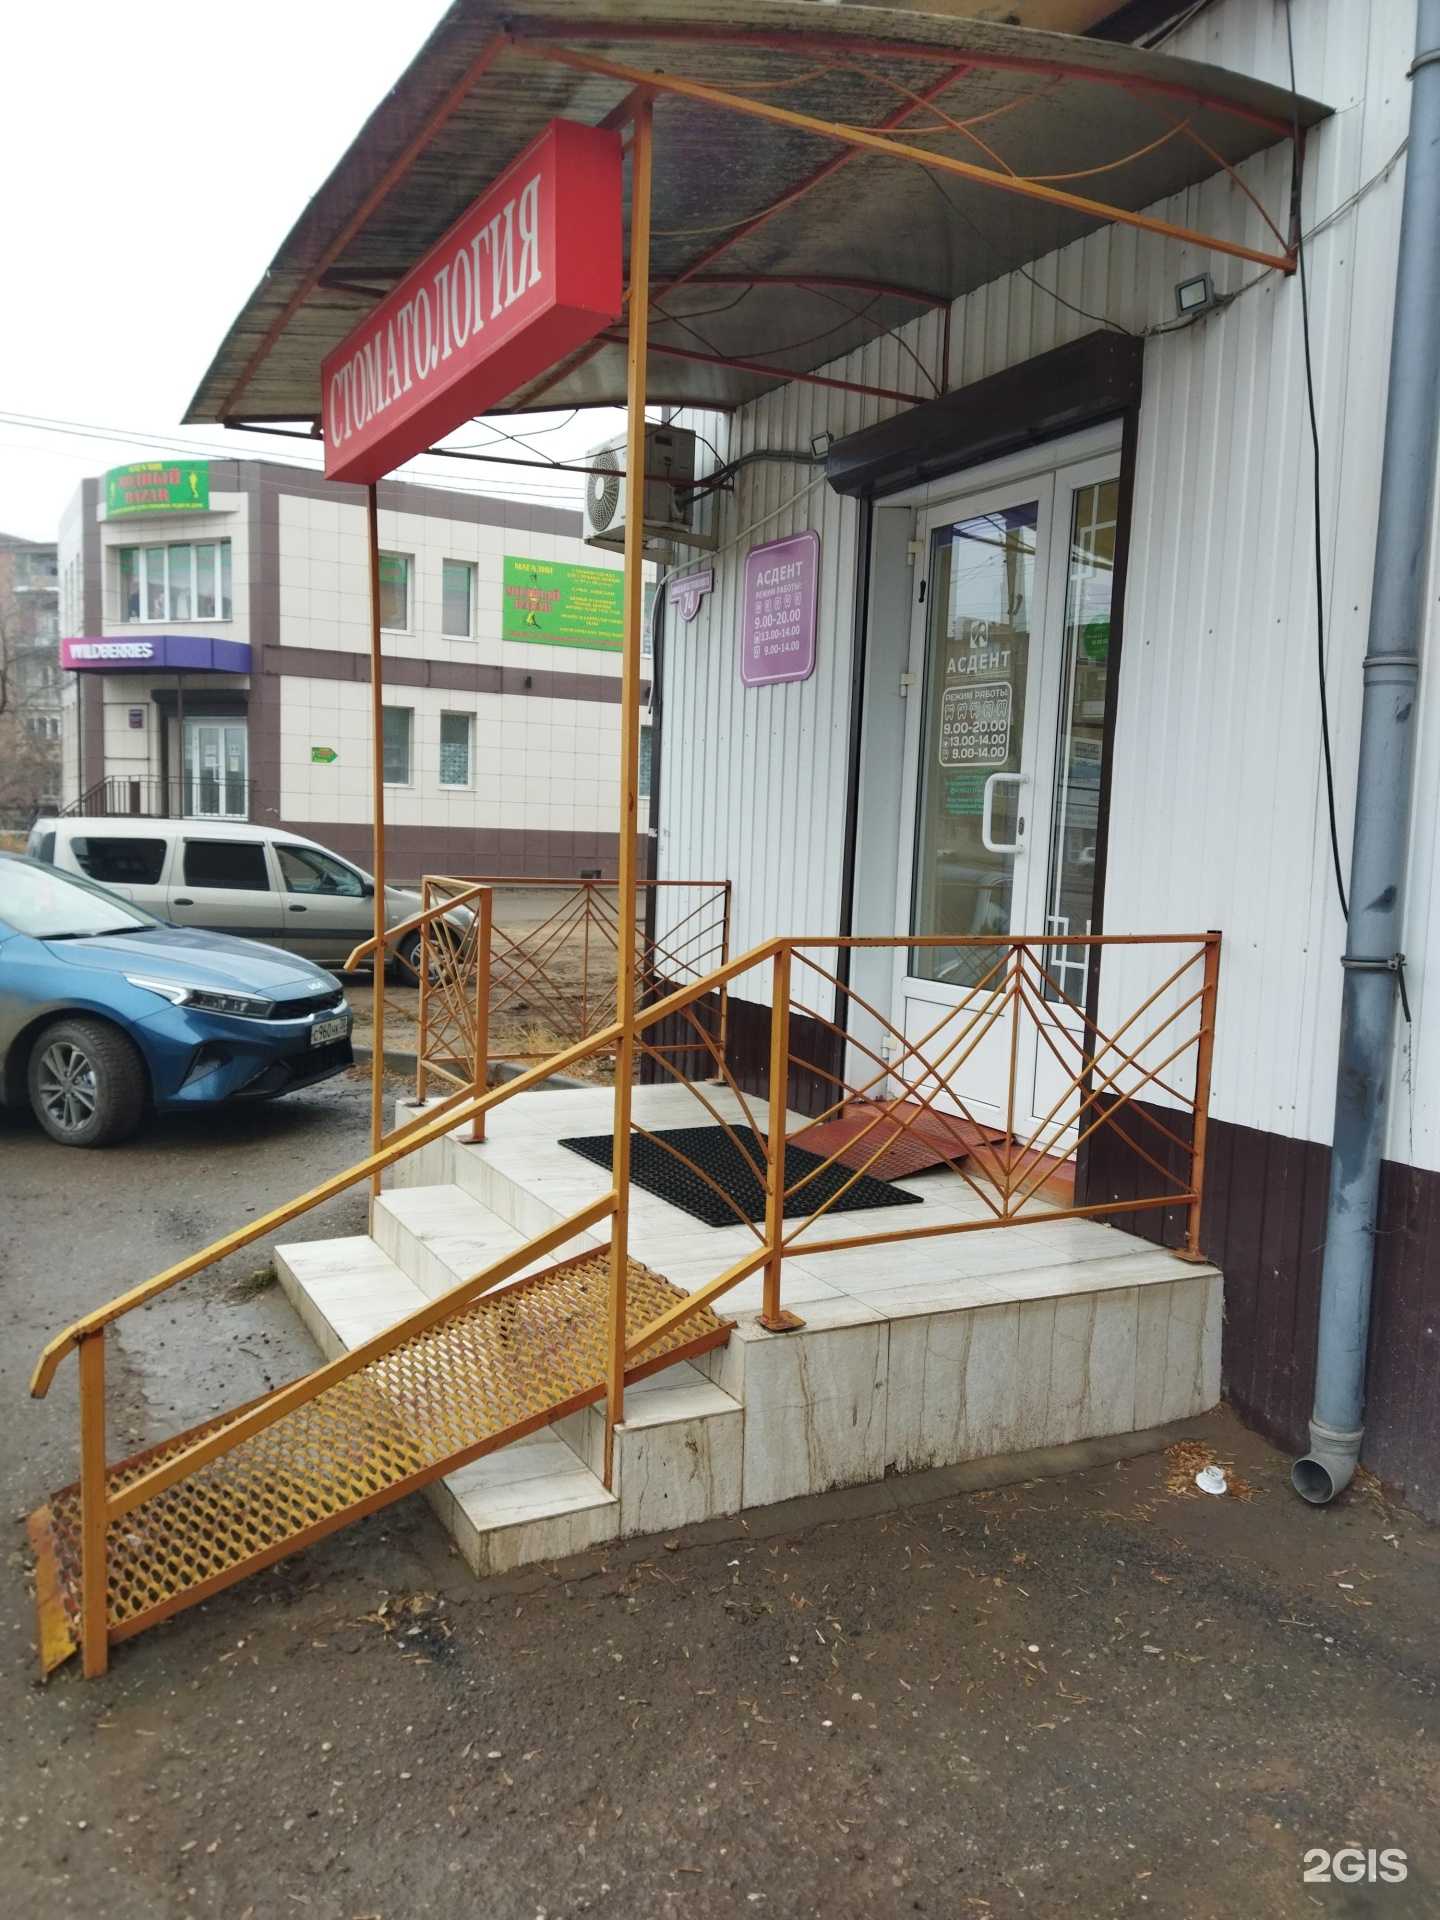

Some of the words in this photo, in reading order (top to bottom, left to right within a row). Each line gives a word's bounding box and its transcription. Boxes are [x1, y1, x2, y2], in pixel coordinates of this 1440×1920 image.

[330, 172, 542, 449] СТОМАТОЛОГИЯ
[756, 561, 803, 588] АСДЕНТ
[754, 608, 801, 630] 9.00-20.00
[760, 625, 801, 641] 13.00-14.00
[69, 643, 154, 659] WILDBERRIES
[763, 640, 801, 656] 9.00-14.00
[947, 651, 1011, 674] АСДЕНТ
[943, 719, 1007, 735] 9.00-20.00
[950, 734, 1006, 748] 13.00-14.00
[952, 746, 1005, 760] 9.00-14.00
